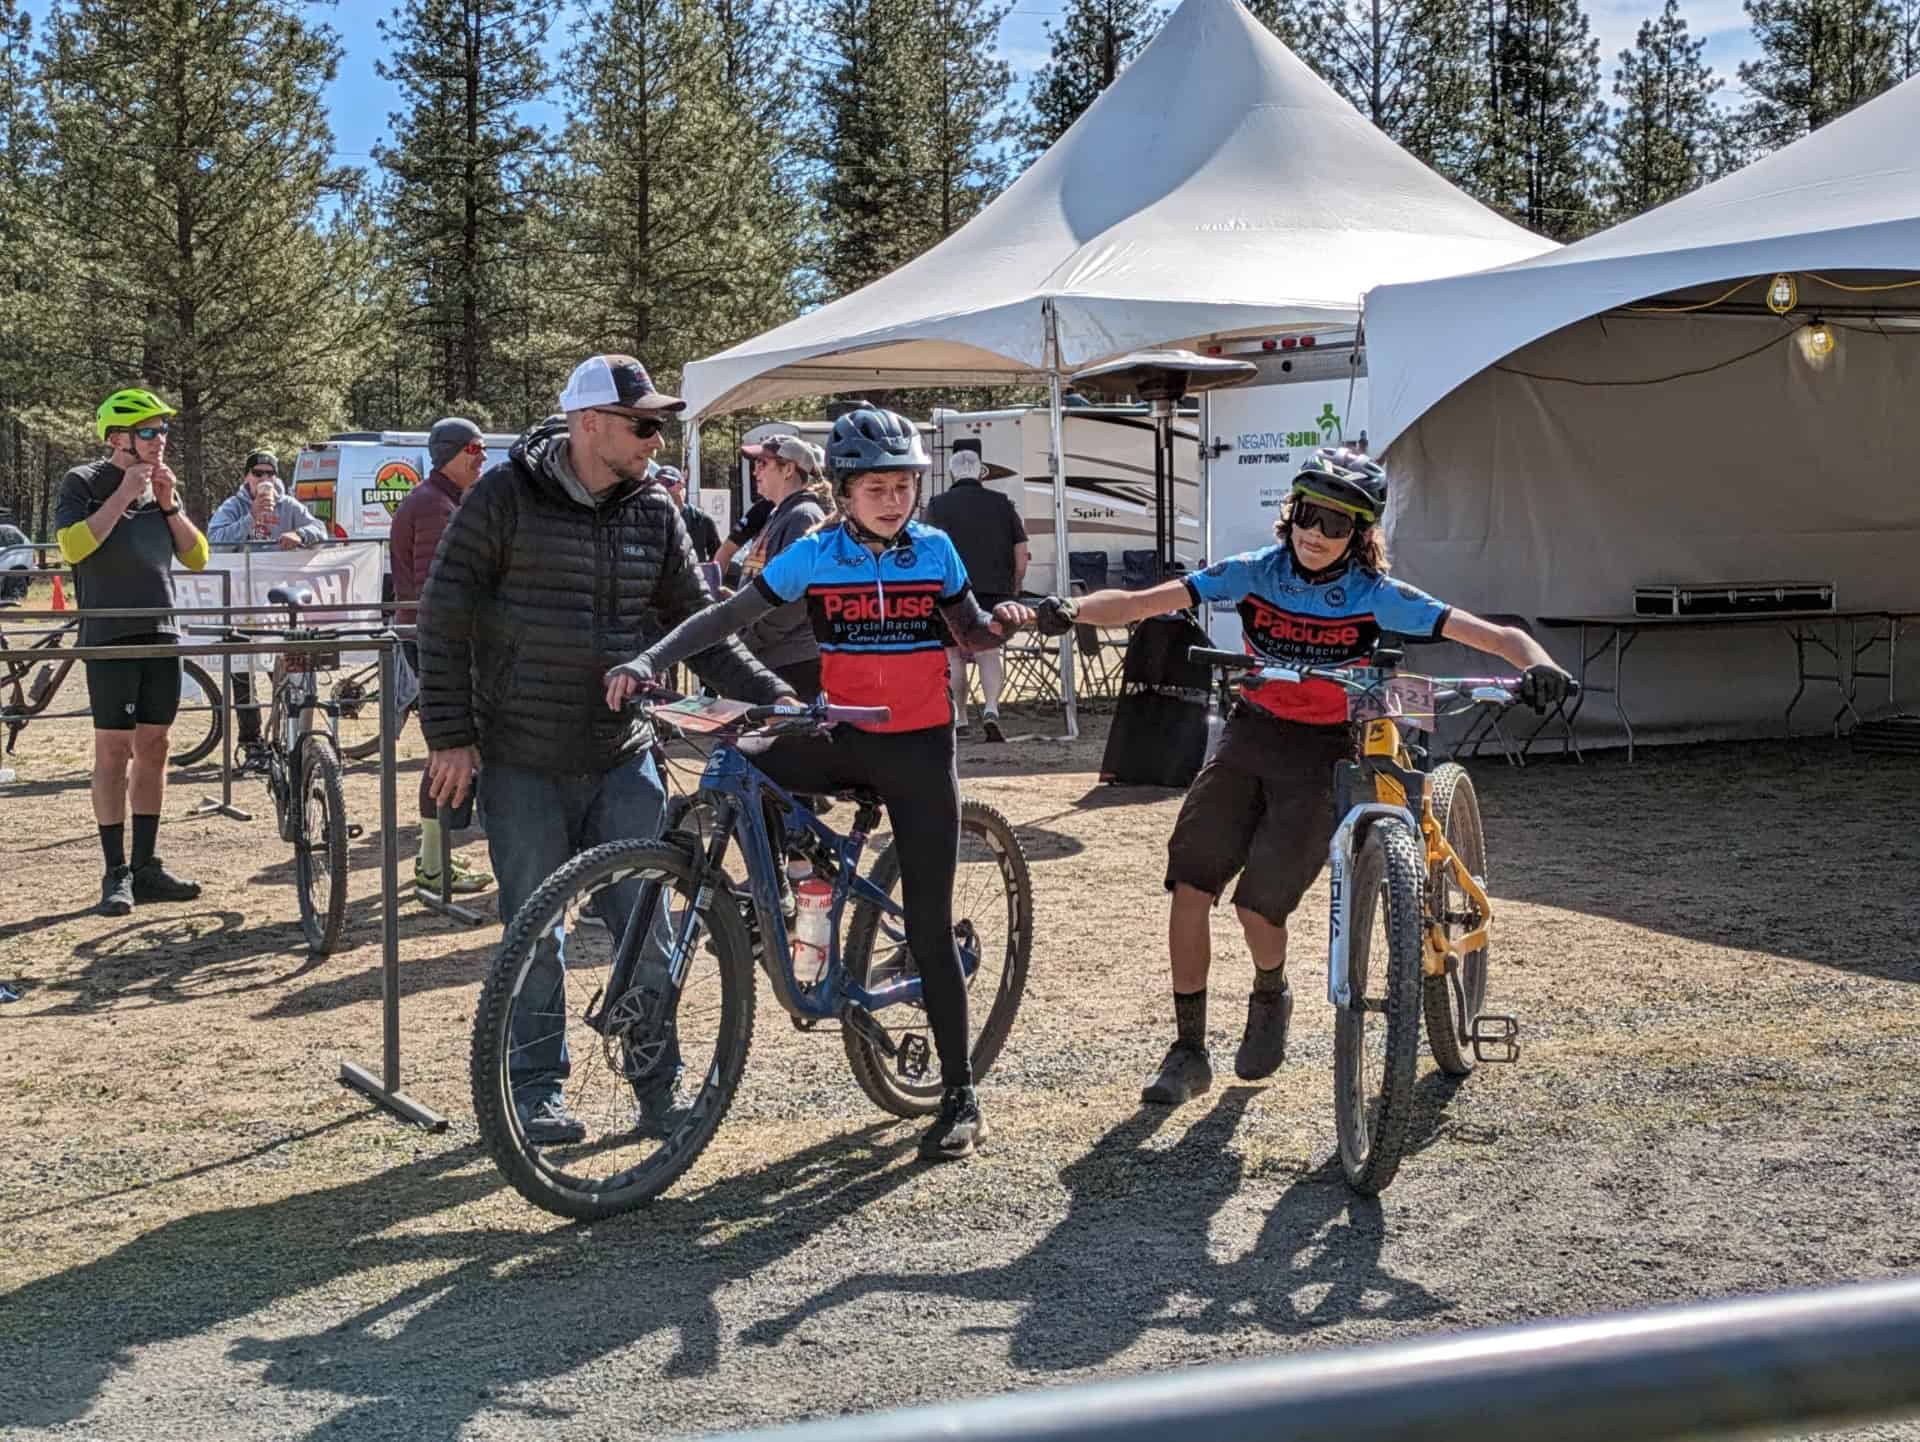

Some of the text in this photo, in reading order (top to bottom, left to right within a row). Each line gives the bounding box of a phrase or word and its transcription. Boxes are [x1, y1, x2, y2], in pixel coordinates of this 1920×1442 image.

[1238, 453, 1290, 464] EVENT TIMING
[1073, 507, 1118, 519] Spirit
[824, 593, 935, 620] Palouse
[886, 620, 928, 632] Racing
[1254, 608, 1360, 646] Palouse
[1306, 644, 1350, 657] Racing
